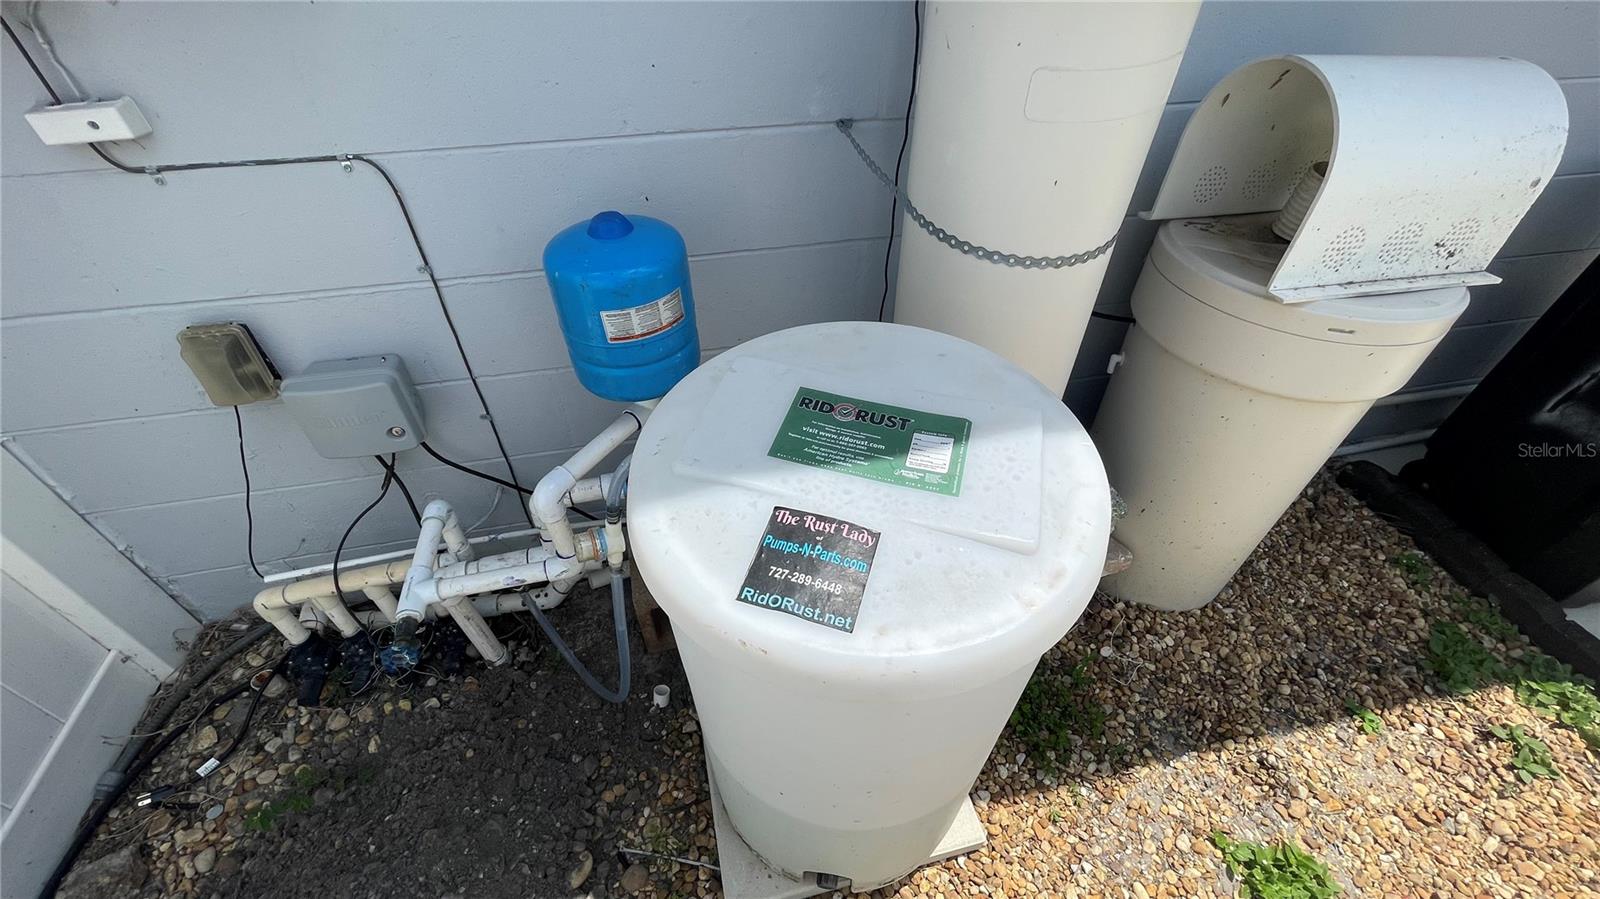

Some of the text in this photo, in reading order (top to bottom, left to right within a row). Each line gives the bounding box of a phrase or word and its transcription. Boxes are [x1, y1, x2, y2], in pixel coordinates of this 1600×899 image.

[803, 426, 818, 435] visit
[819, 430, 885, 450] www.ridorust.com
[775, 510, 876, 548] The Rust Lady
[763, 535, 868, 573] Pumps-N-Parts.com
[768, 566, 843, 595] 727-289-6448
[741, 587, 853, 630] RidORust.net
